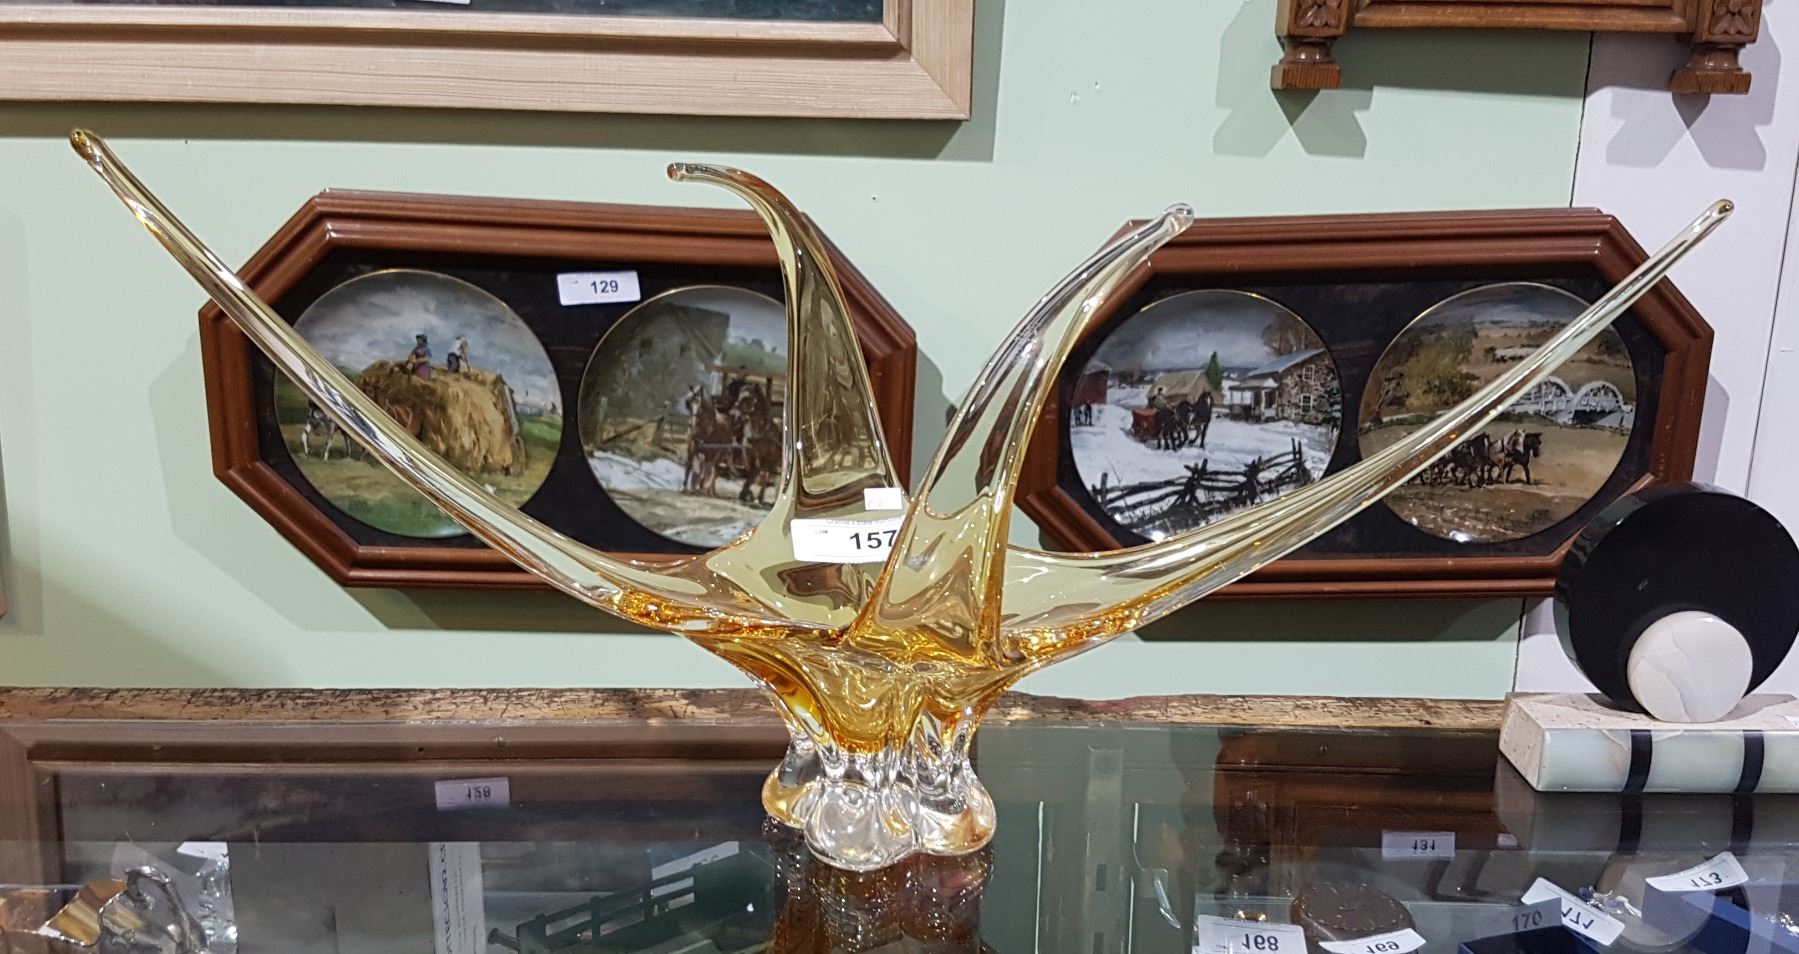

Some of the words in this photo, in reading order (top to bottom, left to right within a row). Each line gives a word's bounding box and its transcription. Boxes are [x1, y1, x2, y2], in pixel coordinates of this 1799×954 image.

[590, 280, 619, 294] 129
[850, 530, 898, 550] 157
[1512, 911, 1543, 932] 170
